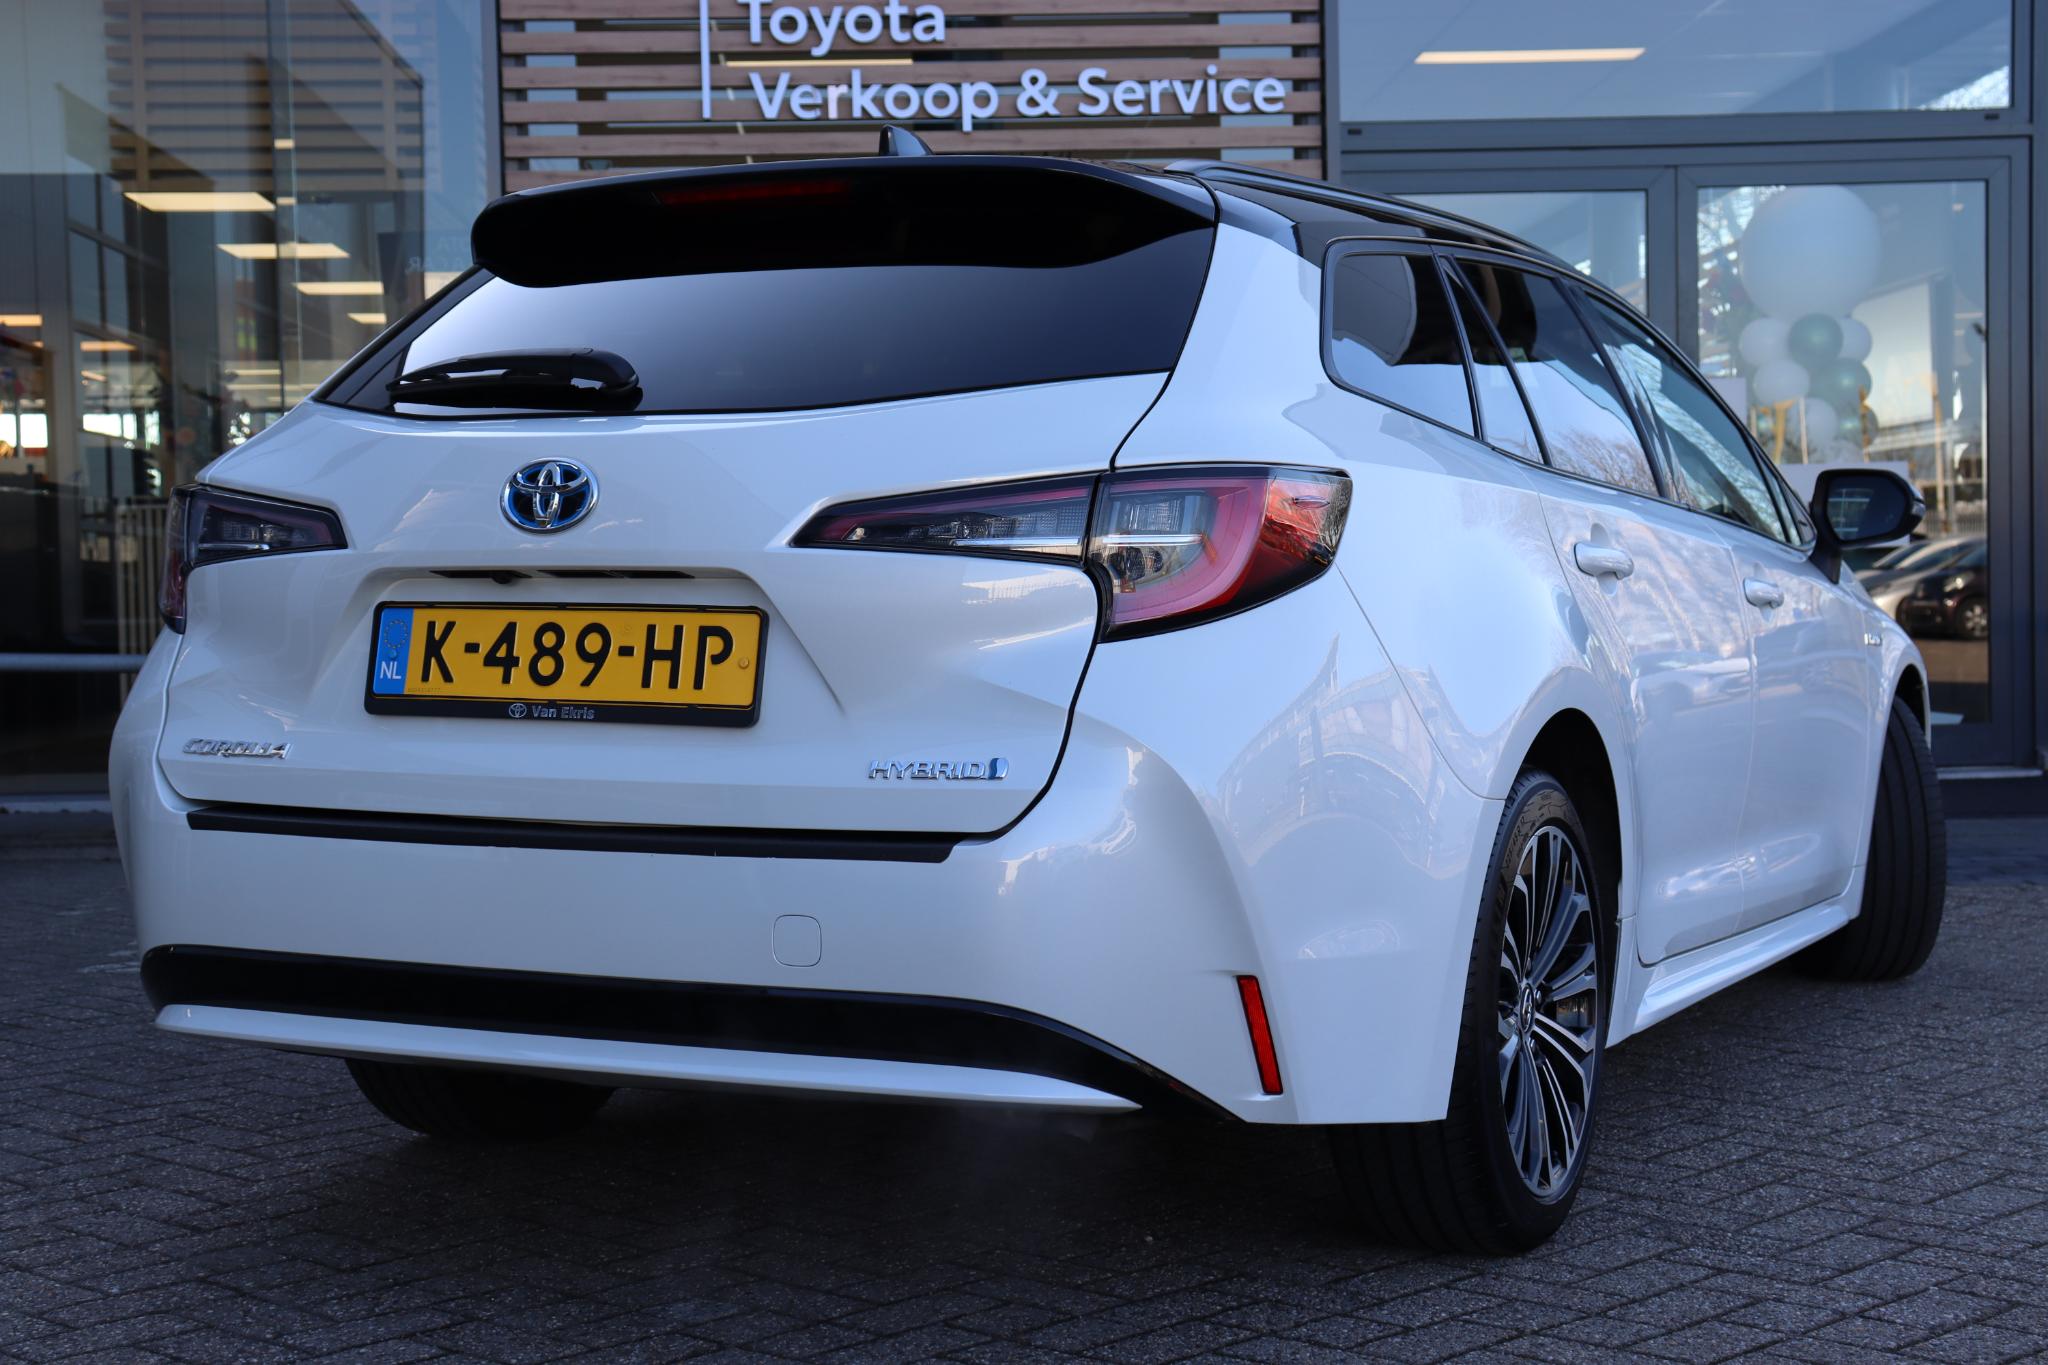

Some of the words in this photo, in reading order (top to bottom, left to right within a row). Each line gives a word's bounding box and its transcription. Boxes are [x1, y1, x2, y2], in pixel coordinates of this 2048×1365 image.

[737, 0, 946, 57] Toyota
[749, 69, 999, 132] Verkoop
[1016, 68, 1060, 116] &
[1077, 64, 1286, 115] Service
[421, 620, 734, 690] K-489-HP
[379, 661, 402, 680] NL
[532, 705, 557, 719] Van
[560, 707, 595, 722] Ekris
[183, 739, 291, 759] COROLLA
[868, 760, 987, 780] HYBRID
